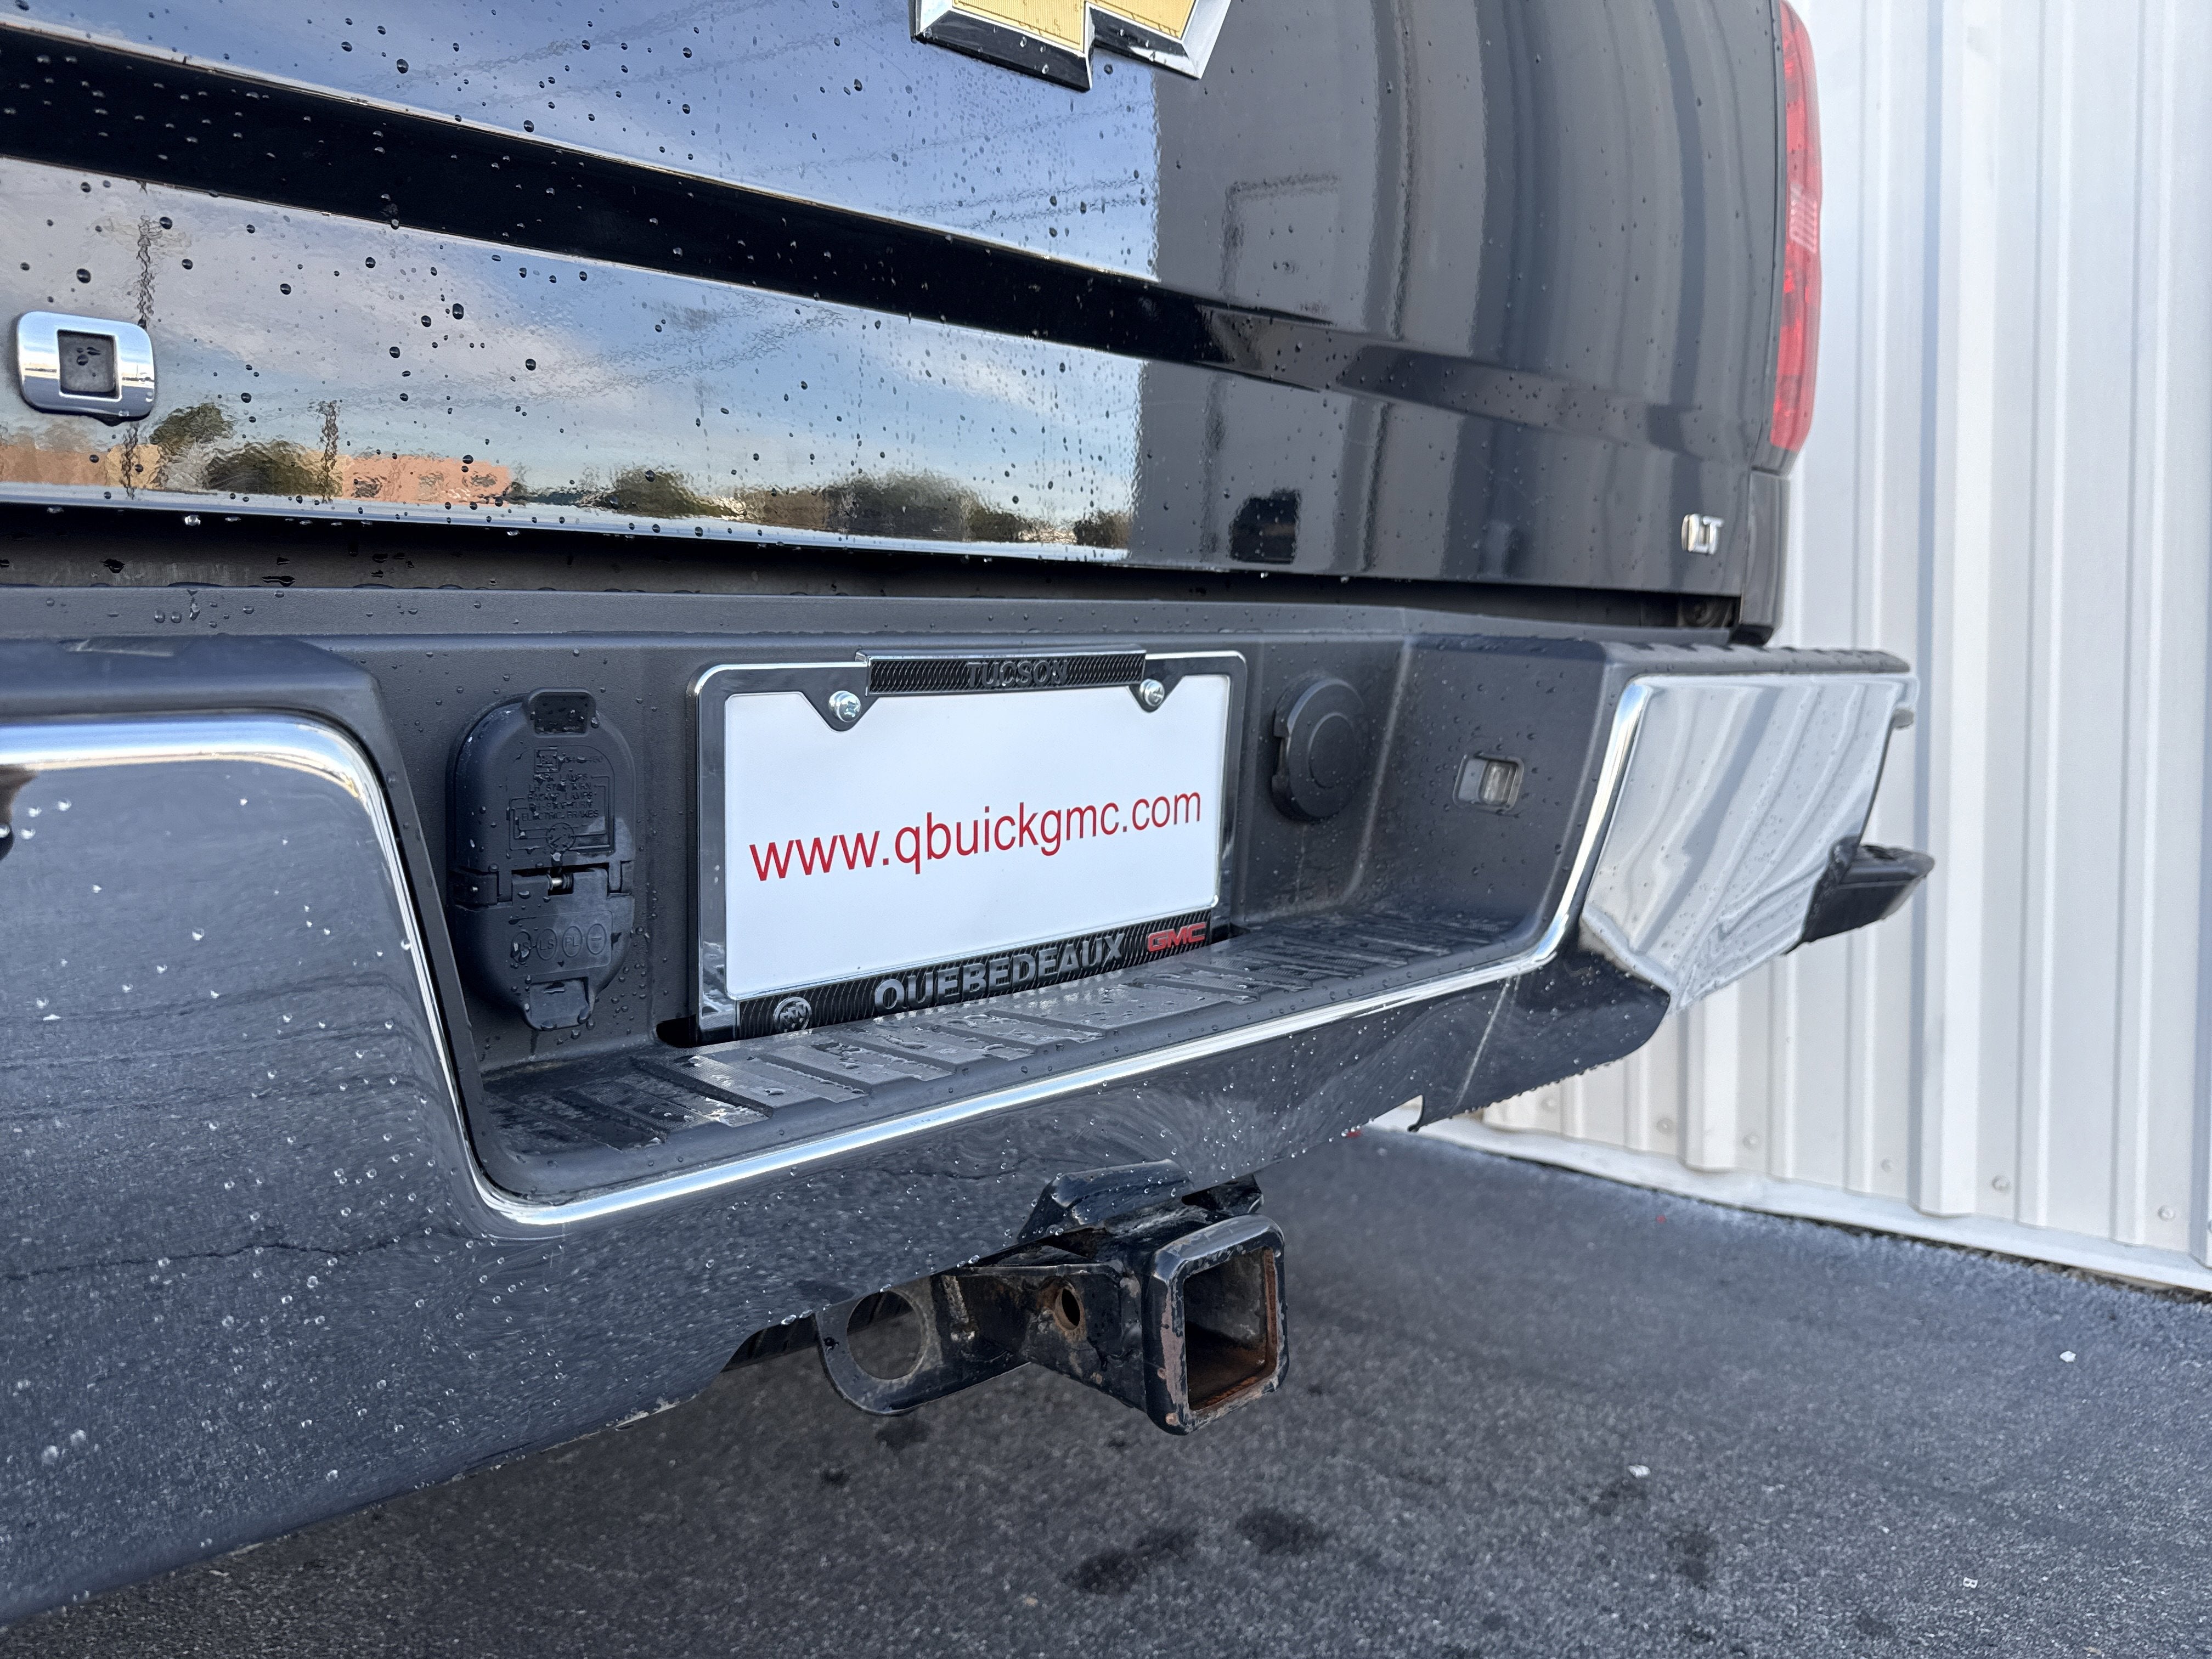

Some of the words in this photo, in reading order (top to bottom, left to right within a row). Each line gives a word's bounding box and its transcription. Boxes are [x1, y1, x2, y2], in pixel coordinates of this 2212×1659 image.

[1681, 514, 1724, 555] LT
[966, 659, 1068, 687] TUCSON
[749, 792, 1200, 881] www.qbuickgmc.com
[540, 939, 554, 950] LS
[565, 936, 579, 947] PL
[874, 933, 1125, 1012] QUEBEDEAUX
[1148, 922, 1206, 952] GMC
